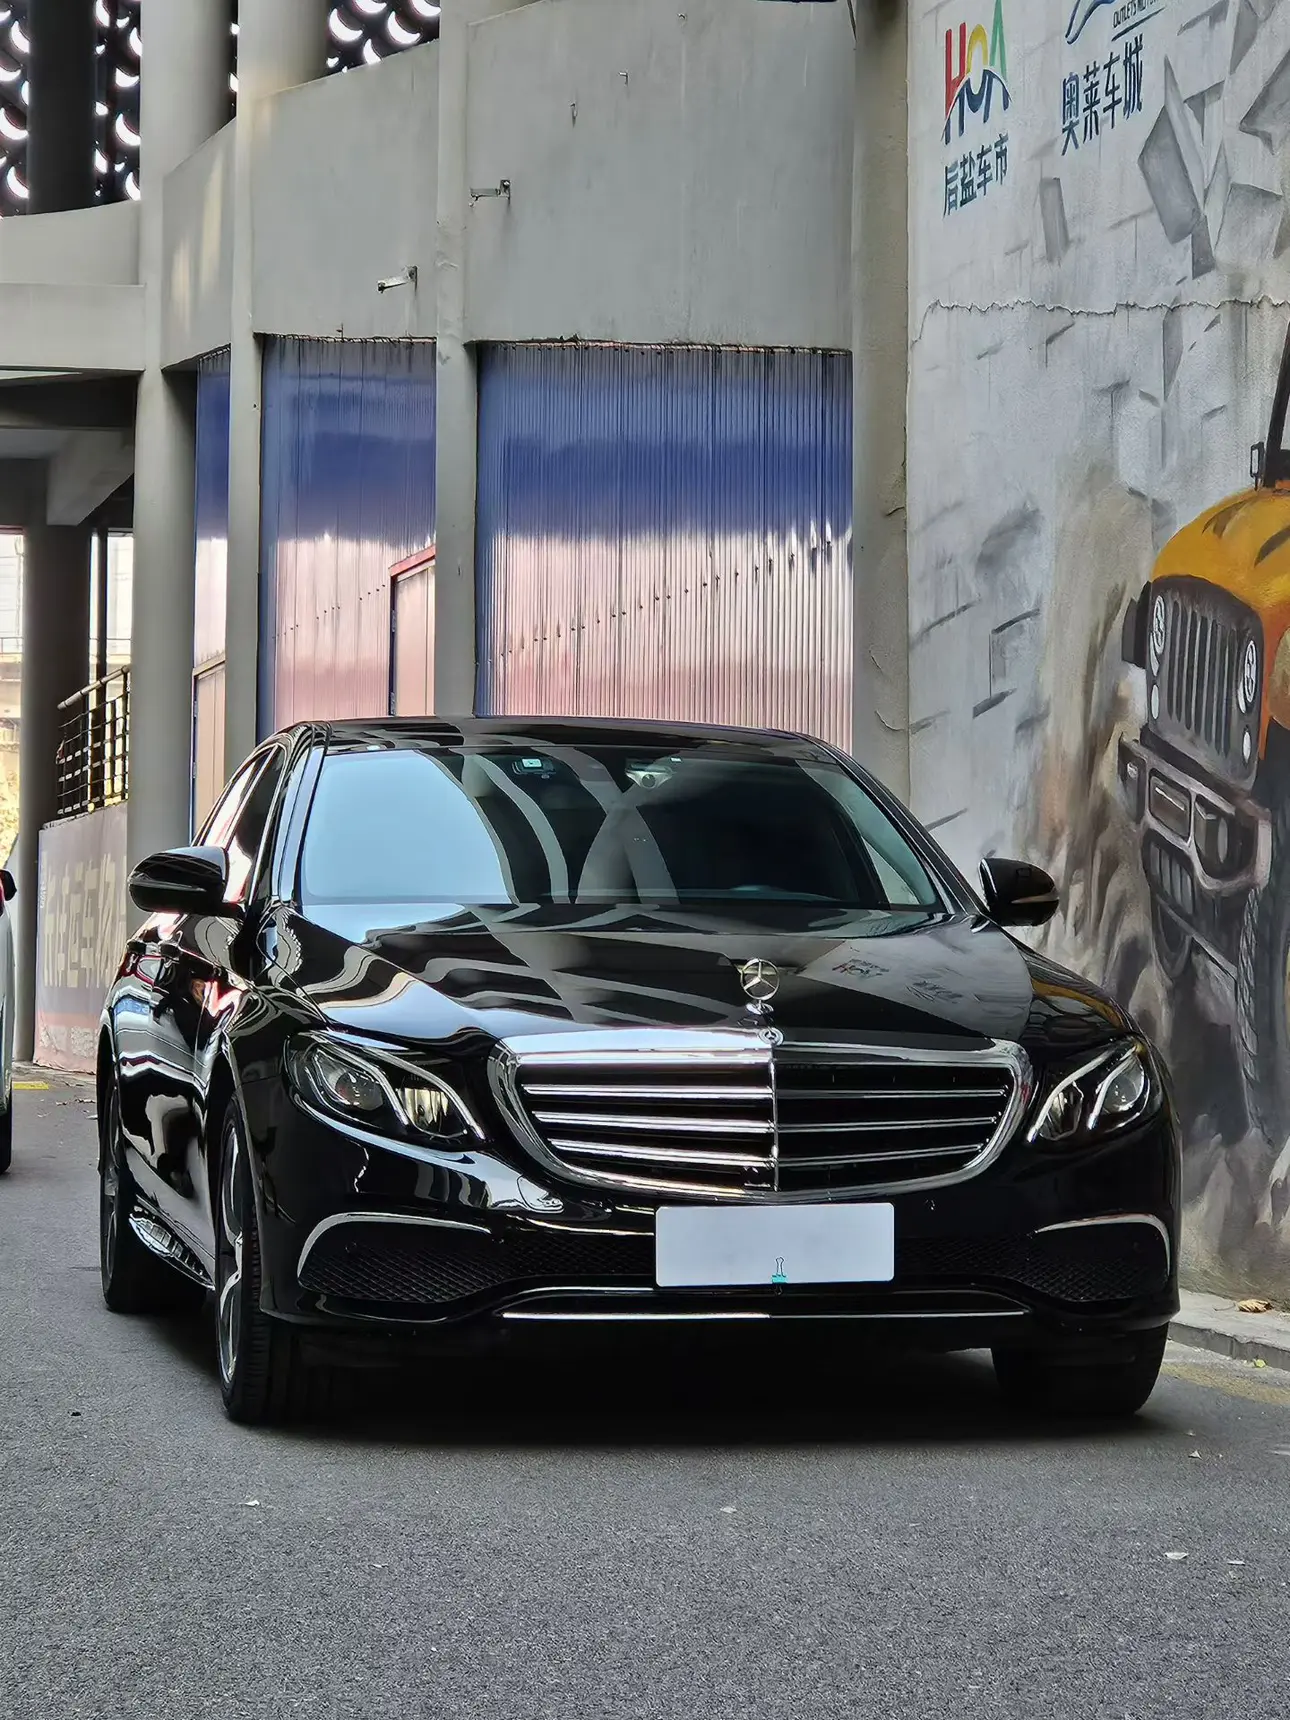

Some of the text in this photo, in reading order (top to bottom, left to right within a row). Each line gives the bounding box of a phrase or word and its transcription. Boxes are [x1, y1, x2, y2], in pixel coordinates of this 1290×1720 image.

[1061, 33, 1143, 156] 奥莱车城
[943, 130, 1009, 218] 后盐车市
